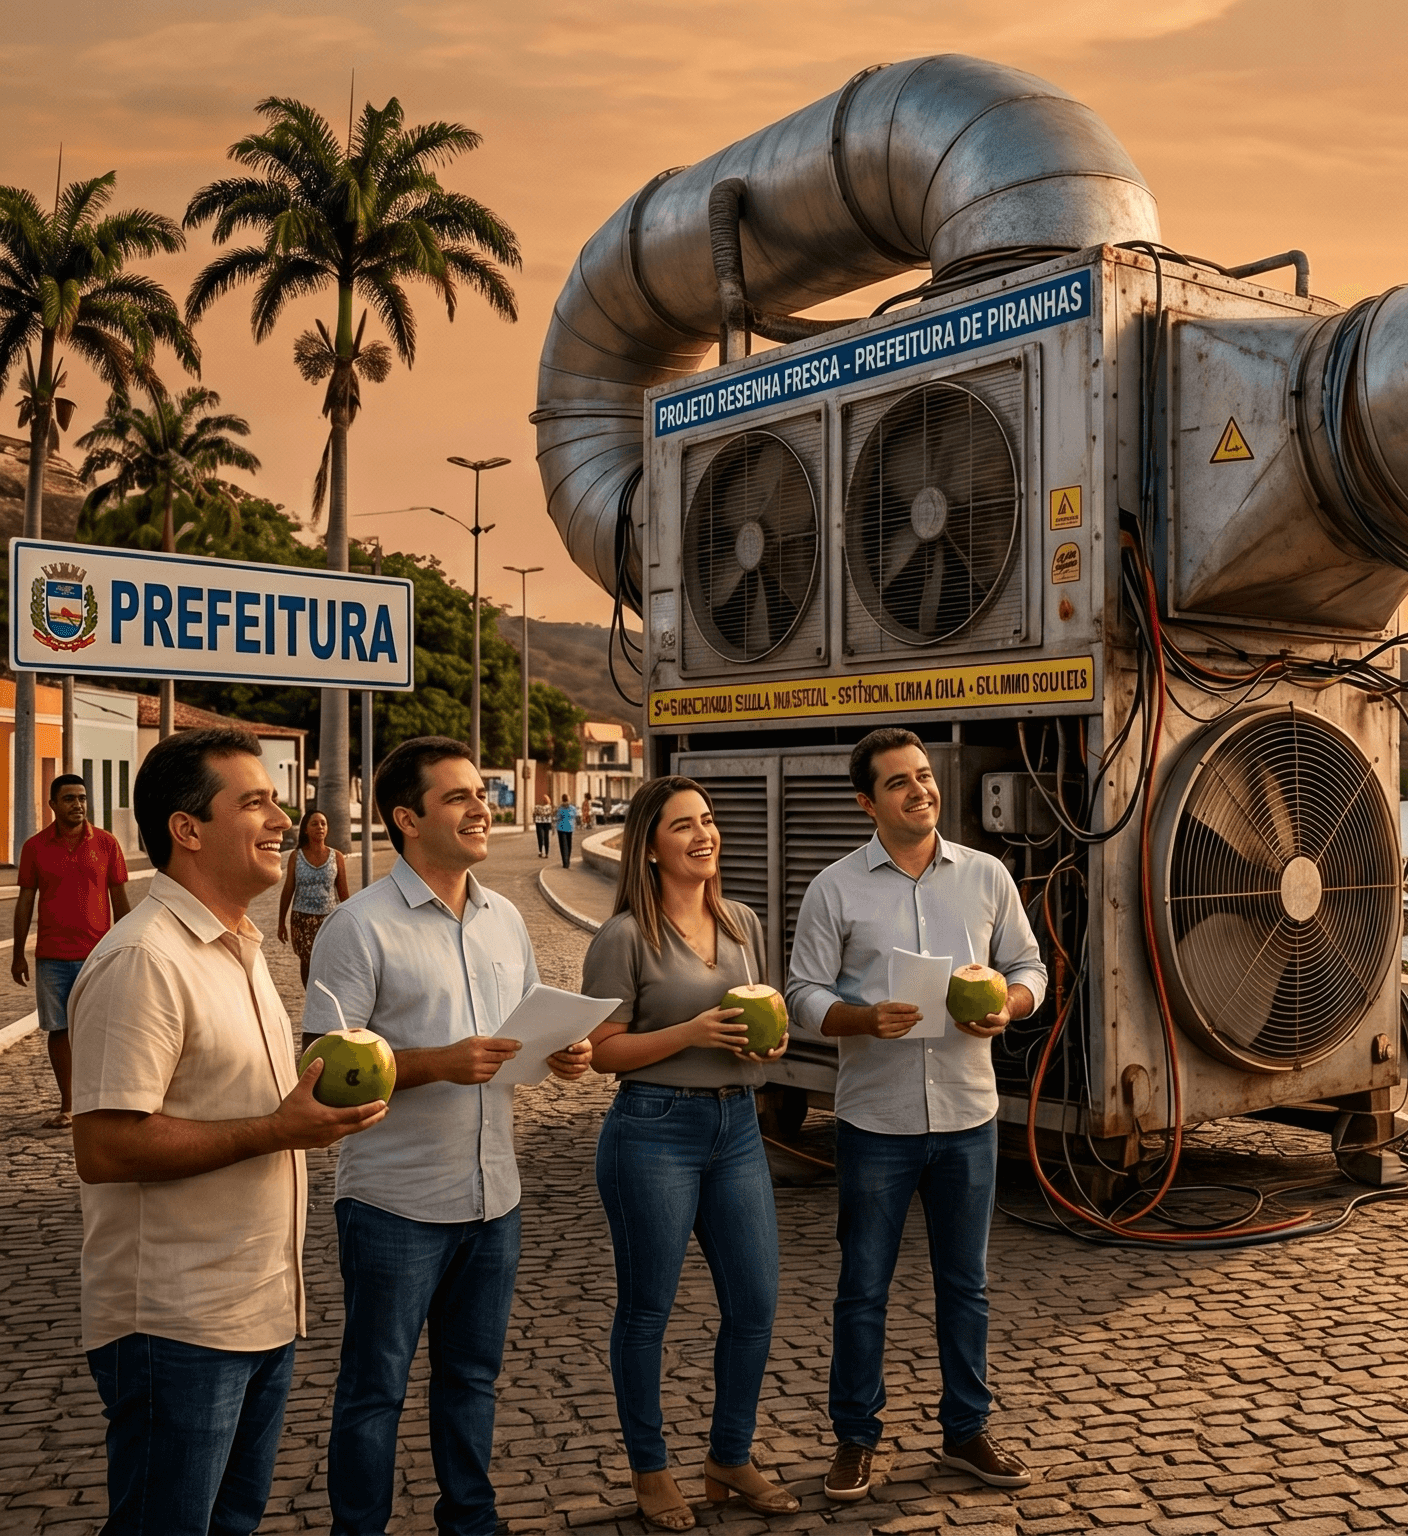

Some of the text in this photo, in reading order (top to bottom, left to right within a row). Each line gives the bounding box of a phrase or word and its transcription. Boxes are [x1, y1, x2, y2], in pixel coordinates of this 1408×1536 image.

[659, 394, 714, 430] PROJETO
[718, 375, 781, 414] RESENHA
[784, 355, 840, 394] FRESCA
[855, 321, 955, 374] PREFEITURA
[959, 311, 983, 344] DE
[987, 281, 1082, 334] PIRANHAS
[111, 580, 398, 663] PREFEITURA
